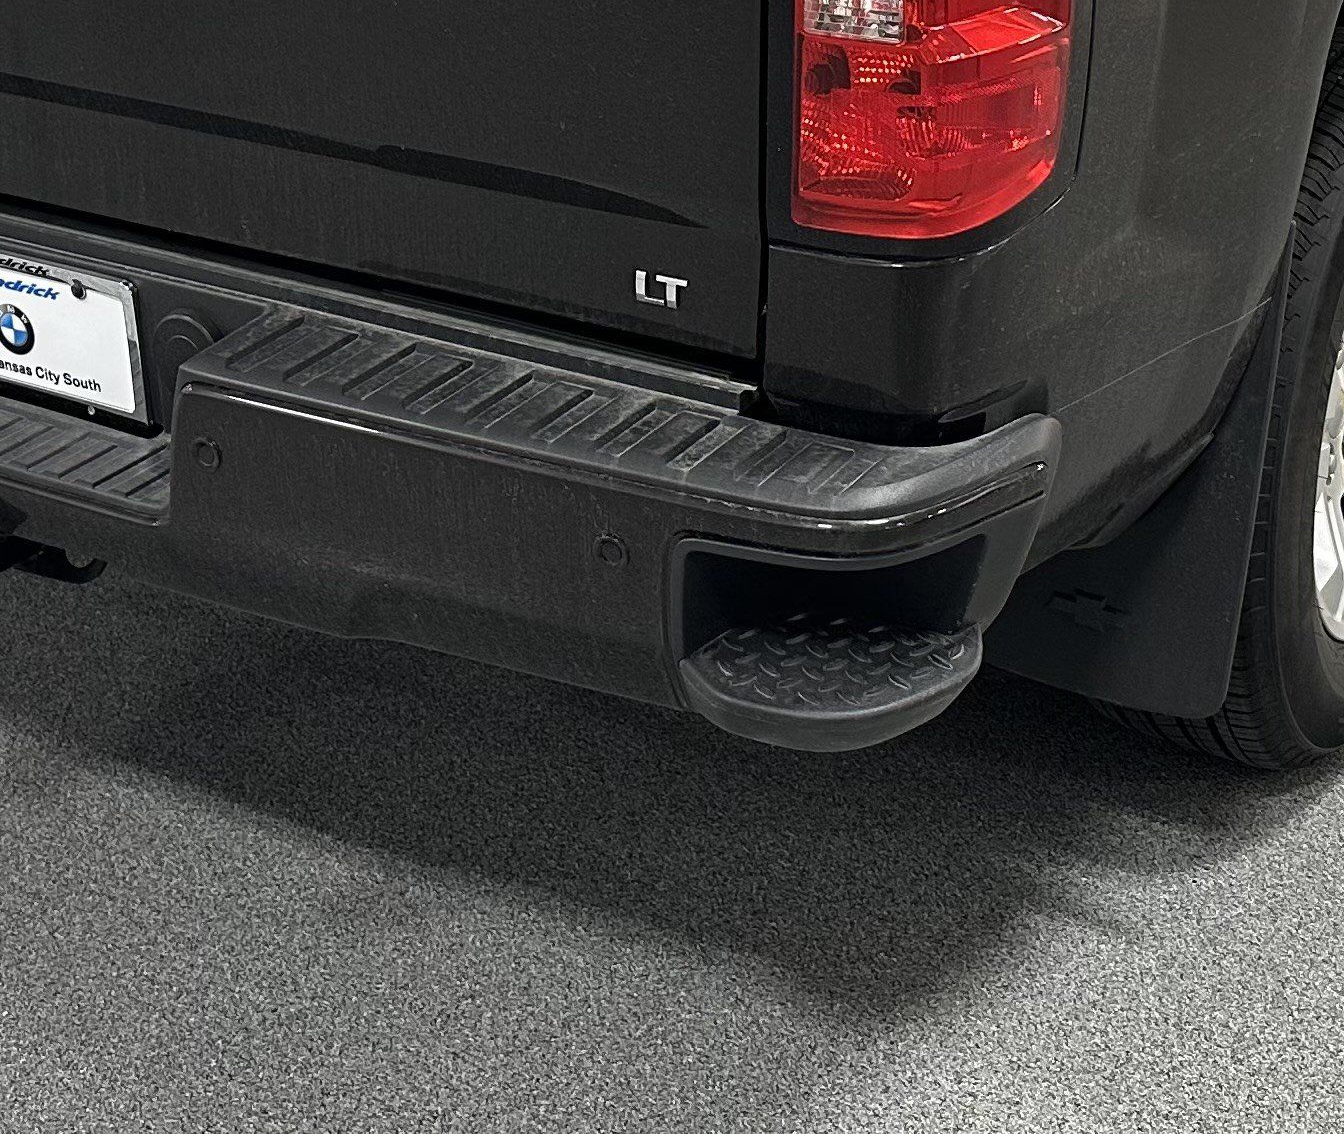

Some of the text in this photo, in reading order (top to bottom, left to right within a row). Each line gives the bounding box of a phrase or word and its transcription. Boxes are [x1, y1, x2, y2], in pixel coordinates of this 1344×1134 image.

[636, 270, 688, 309] LT
[36, 367, 60, 385] City
[63, 373, 102, 393] South
